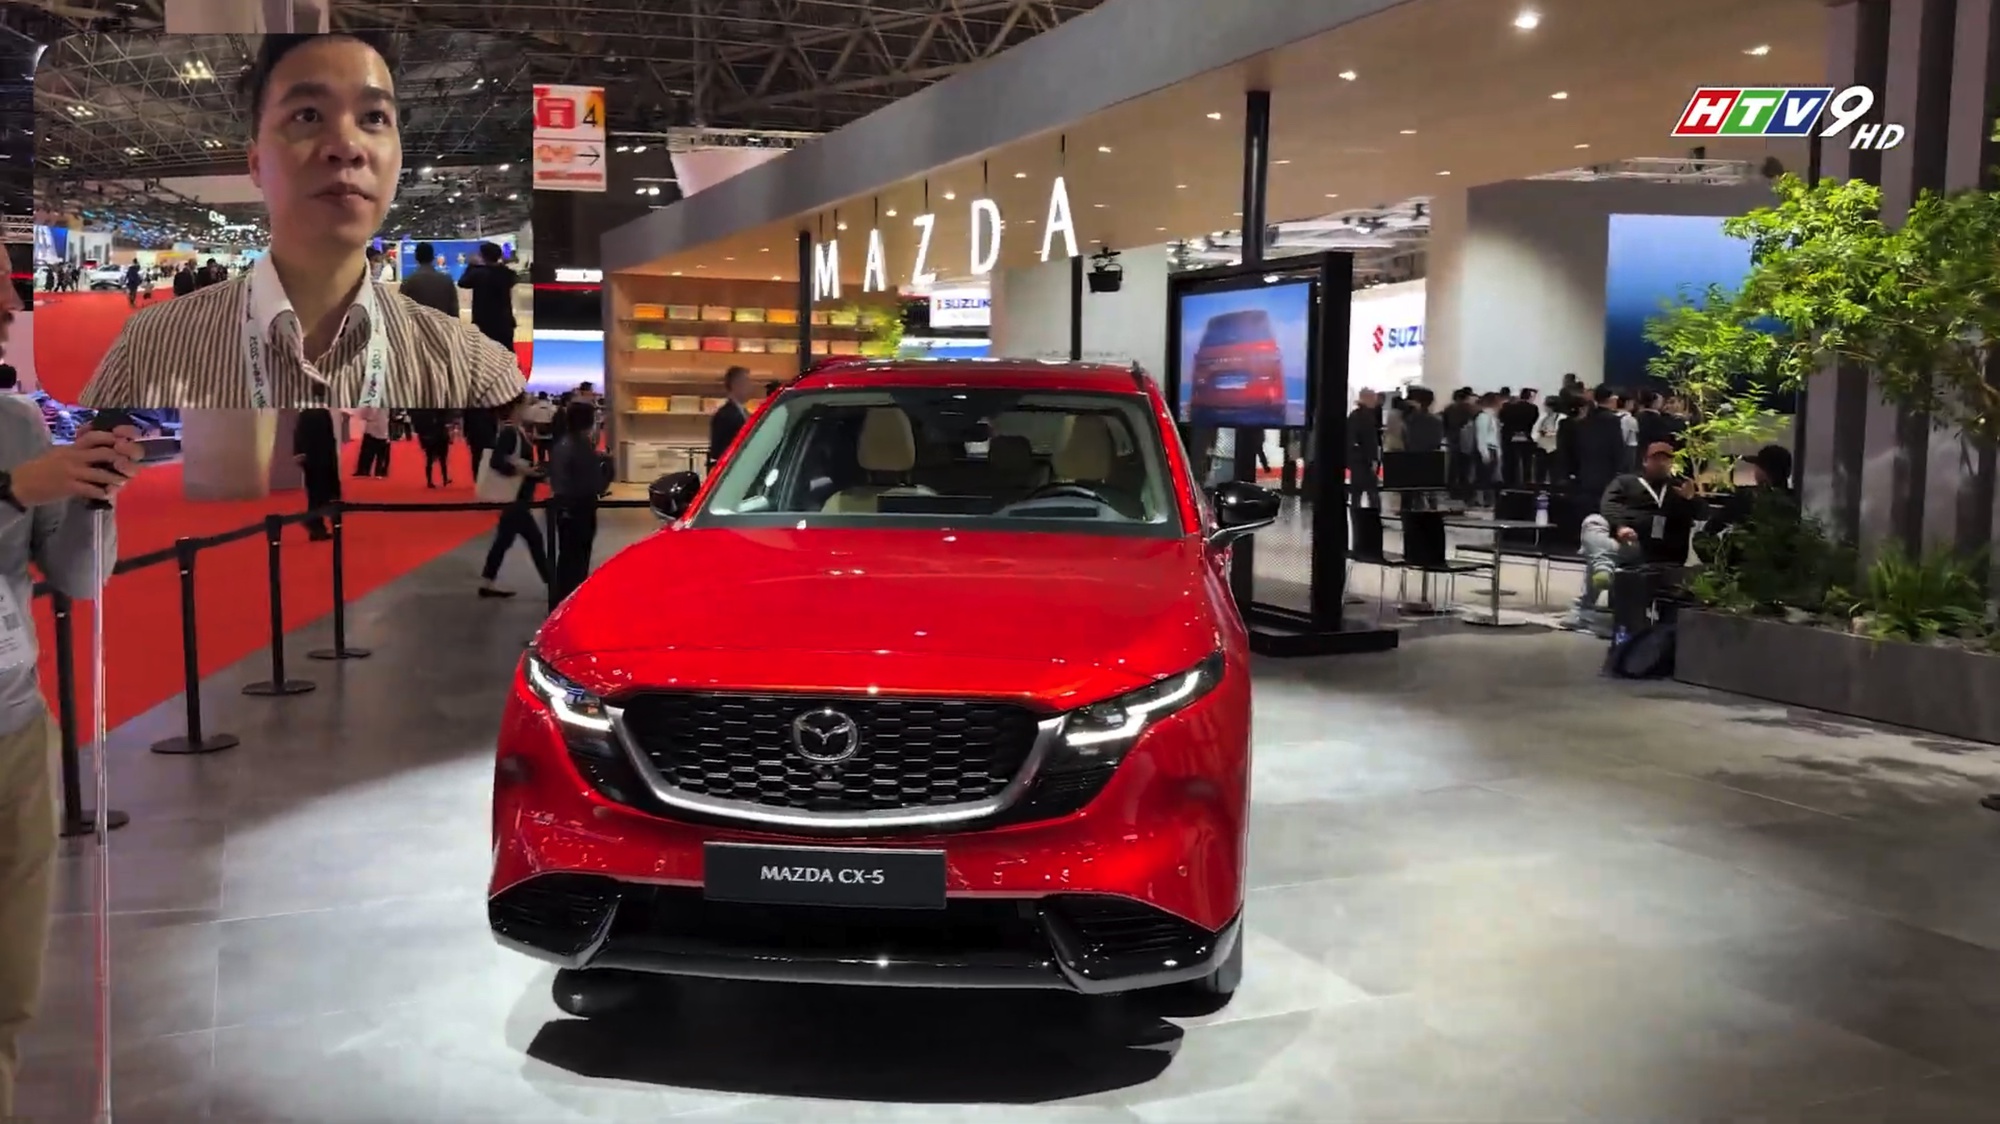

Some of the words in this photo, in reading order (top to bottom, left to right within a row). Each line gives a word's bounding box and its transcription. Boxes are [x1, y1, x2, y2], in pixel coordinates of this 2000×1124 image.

[582, 103, 599, 128] 4
[814, 176, 1080, 301] MAZDA
[760, 865, 834, 883] MAZDA
[838, 868, 885, 885] CX-5
